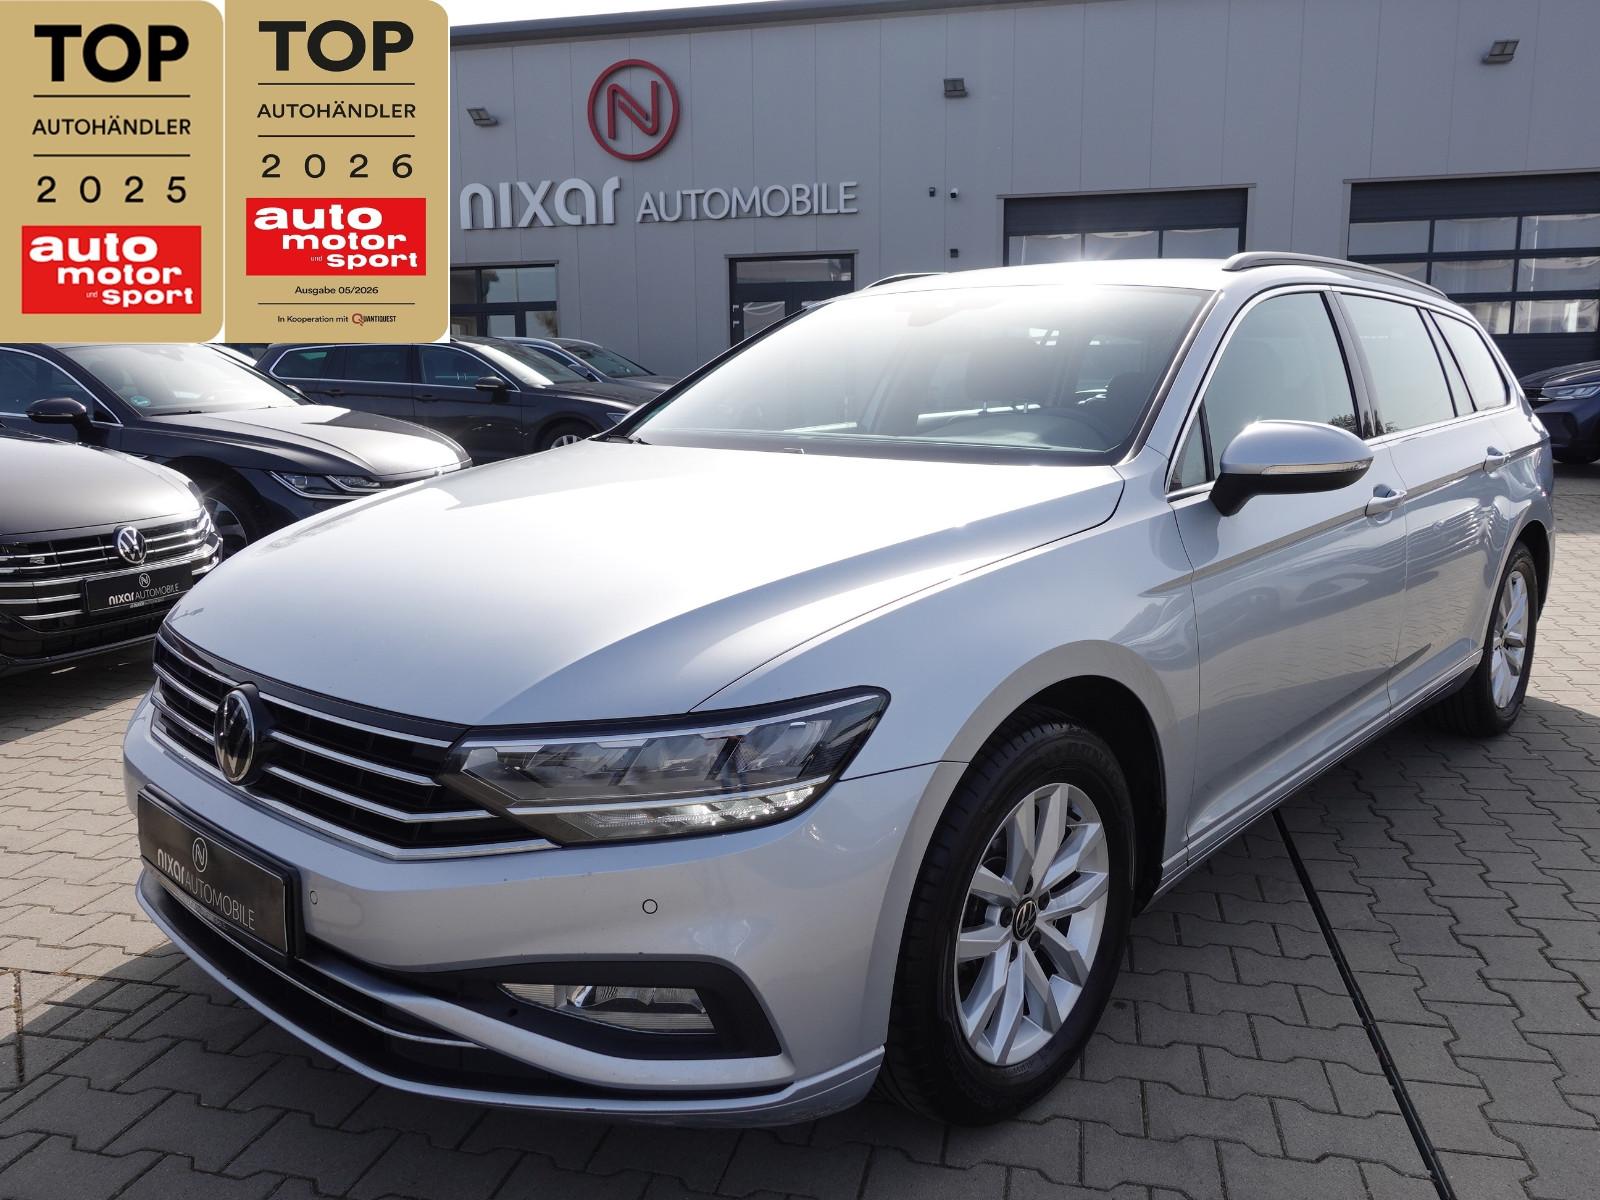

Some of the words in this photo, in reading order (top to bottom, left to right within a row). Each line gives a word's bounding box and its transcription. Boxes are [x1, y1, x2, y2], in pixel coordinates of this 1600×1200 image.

[460, 176, 621, 230] nixar
[636, 181, 859, 223] AUTOMOBILE
[108, 592, 135, 606] nixar
[135, 583, 179, 600] AUTOMOBILE
[157, 848, 185, 885] nixar
[185, 871, 255, 931] AUTOMOBILE
